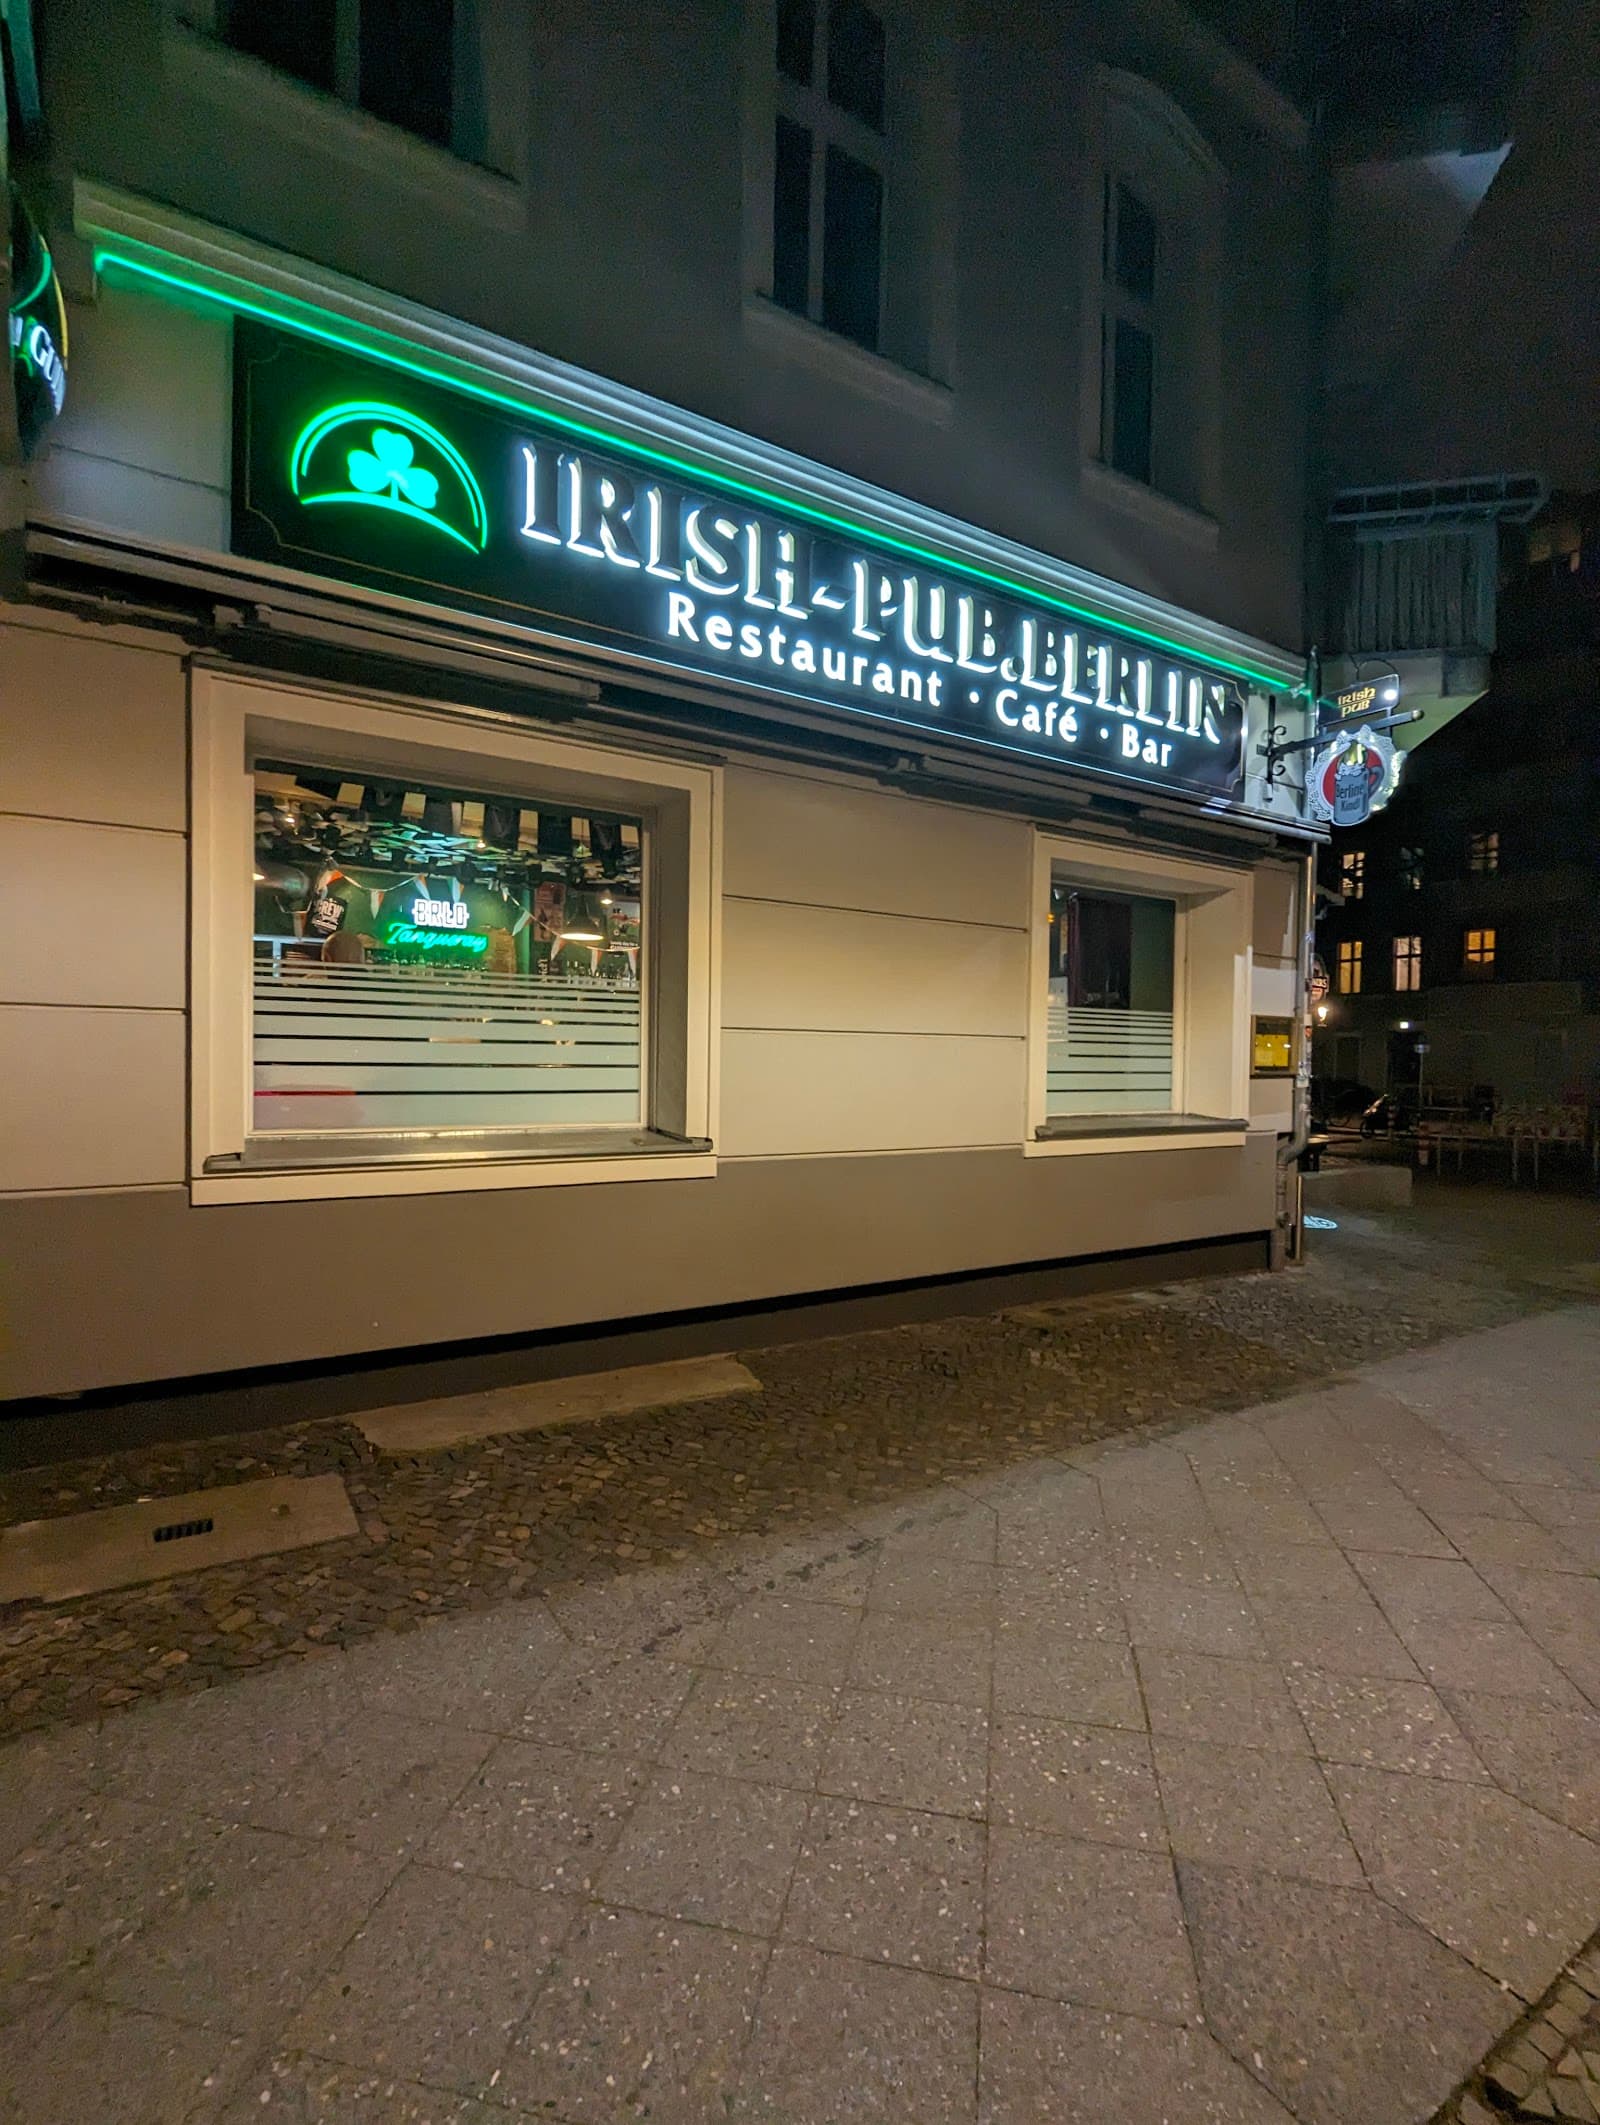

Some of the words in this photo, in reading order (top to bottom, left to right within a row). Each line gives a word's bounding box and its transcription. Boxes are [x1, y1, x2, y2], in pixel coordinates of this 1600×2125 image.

[667, 591, 943, 706] Restaurant
[996, 689, 1078, 743] Café
[1122, 724, 1173, 768] Bar
[1020, 616, 1232, 745] BERLIN
